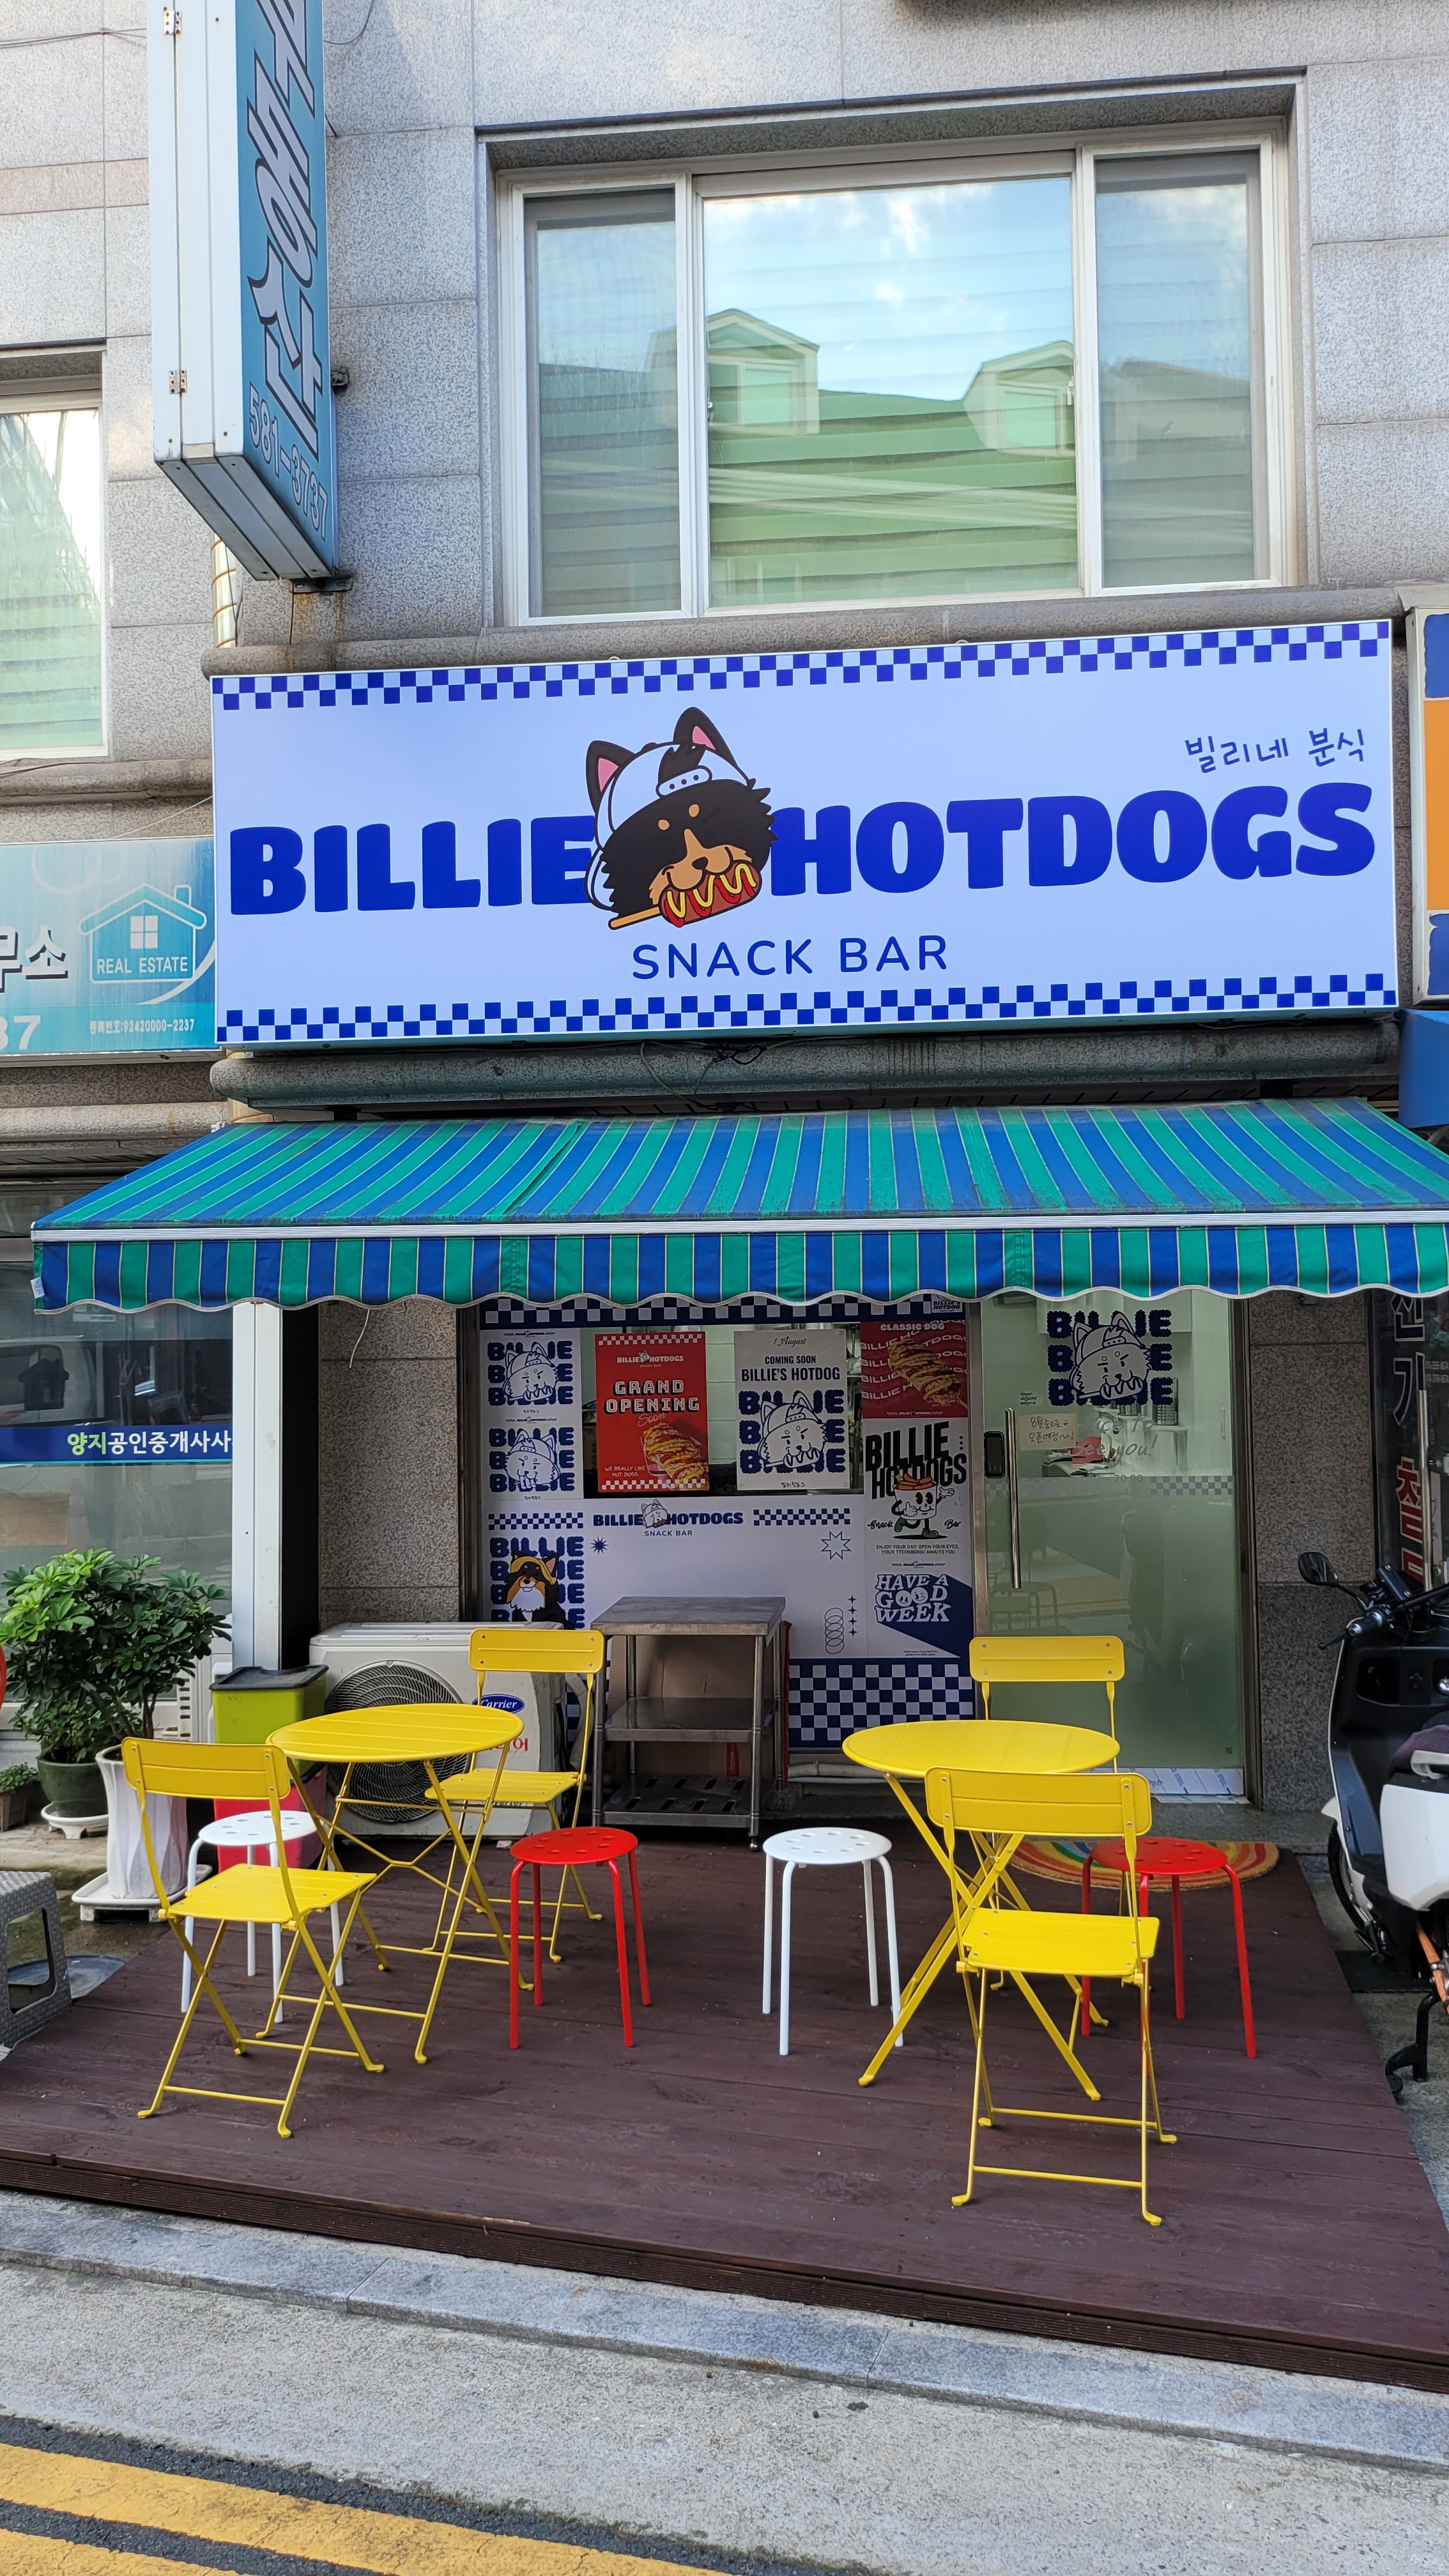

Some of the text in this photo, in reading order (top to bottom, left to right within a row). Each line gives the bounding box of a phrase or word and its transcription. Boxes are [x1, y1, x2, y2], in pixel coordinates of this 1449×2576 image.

[249, 382, 327, 542] 581-3737
[1185, 728, 1366, 773] 빌리네 분식
[230, 782, 1376, 916] BILLIE HOTDOGS
[96, 956, 188, 974] REAL ESTATE
[632, 935, 947, 979] SNACK BAR
[1047, 1310, 1172, 1338] BIE
[487, 1340, 573, 1361] BIE
[765, 1355, 816, 1365] COMING SOON
[741, 1367, 840, 1382] BILLIE'S HOTDOG
[614, 1380, 684, 1395] GRAND
[605, 1397, 700, 1413] OPENING
[739, 1389, 844, 1415] BIE
[638, 1413, 667, 1426] Soon
[67, 1429, 233, 1456] 양지공인중개사사
[865, 1421, 949, 1472] BILLIE
[593, 1512, 744, 1526] BILLIE HOTDOGS
[867, 1519, 962, 1529] Snack Bar
[875, 1574, 949, 1591] HAVE A
[875, 1602, 951, 1622] WEEK
